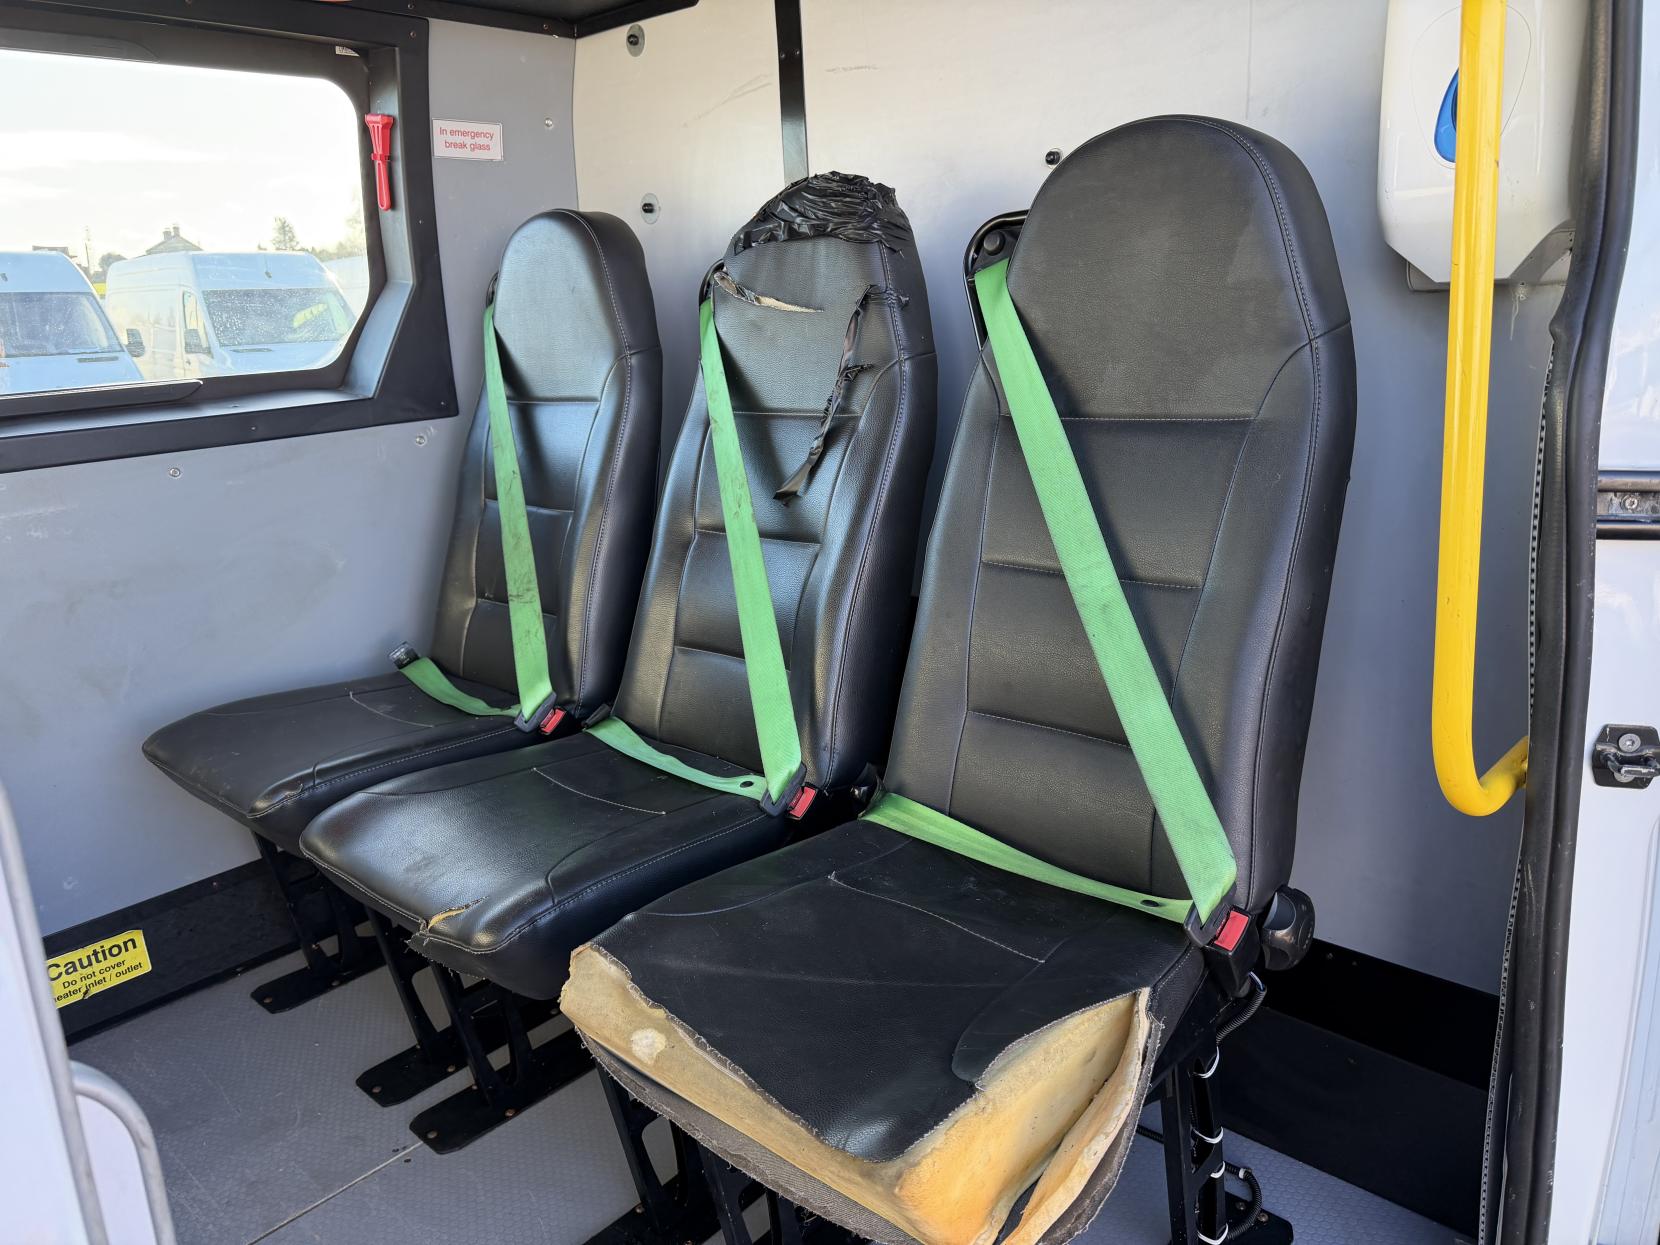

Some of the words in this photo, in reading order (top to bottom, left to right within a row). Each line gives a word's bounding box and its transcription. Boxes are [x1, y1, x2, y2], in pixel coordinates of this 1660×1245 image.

[439, 127, 447, 136] In
[449, 129, 494, 141] emergency
[445, 140, 468, 149] break
[470, 142, 491, 152] glass
[47, 938, 137, 981] Caution
[62, 979, 78, 989] Do
[80, 970, 97, 983] not
[98, 959, 126, 975] cover
[85, 976, 106, 991] inlet
[115, 962, 143, 977] outlet
